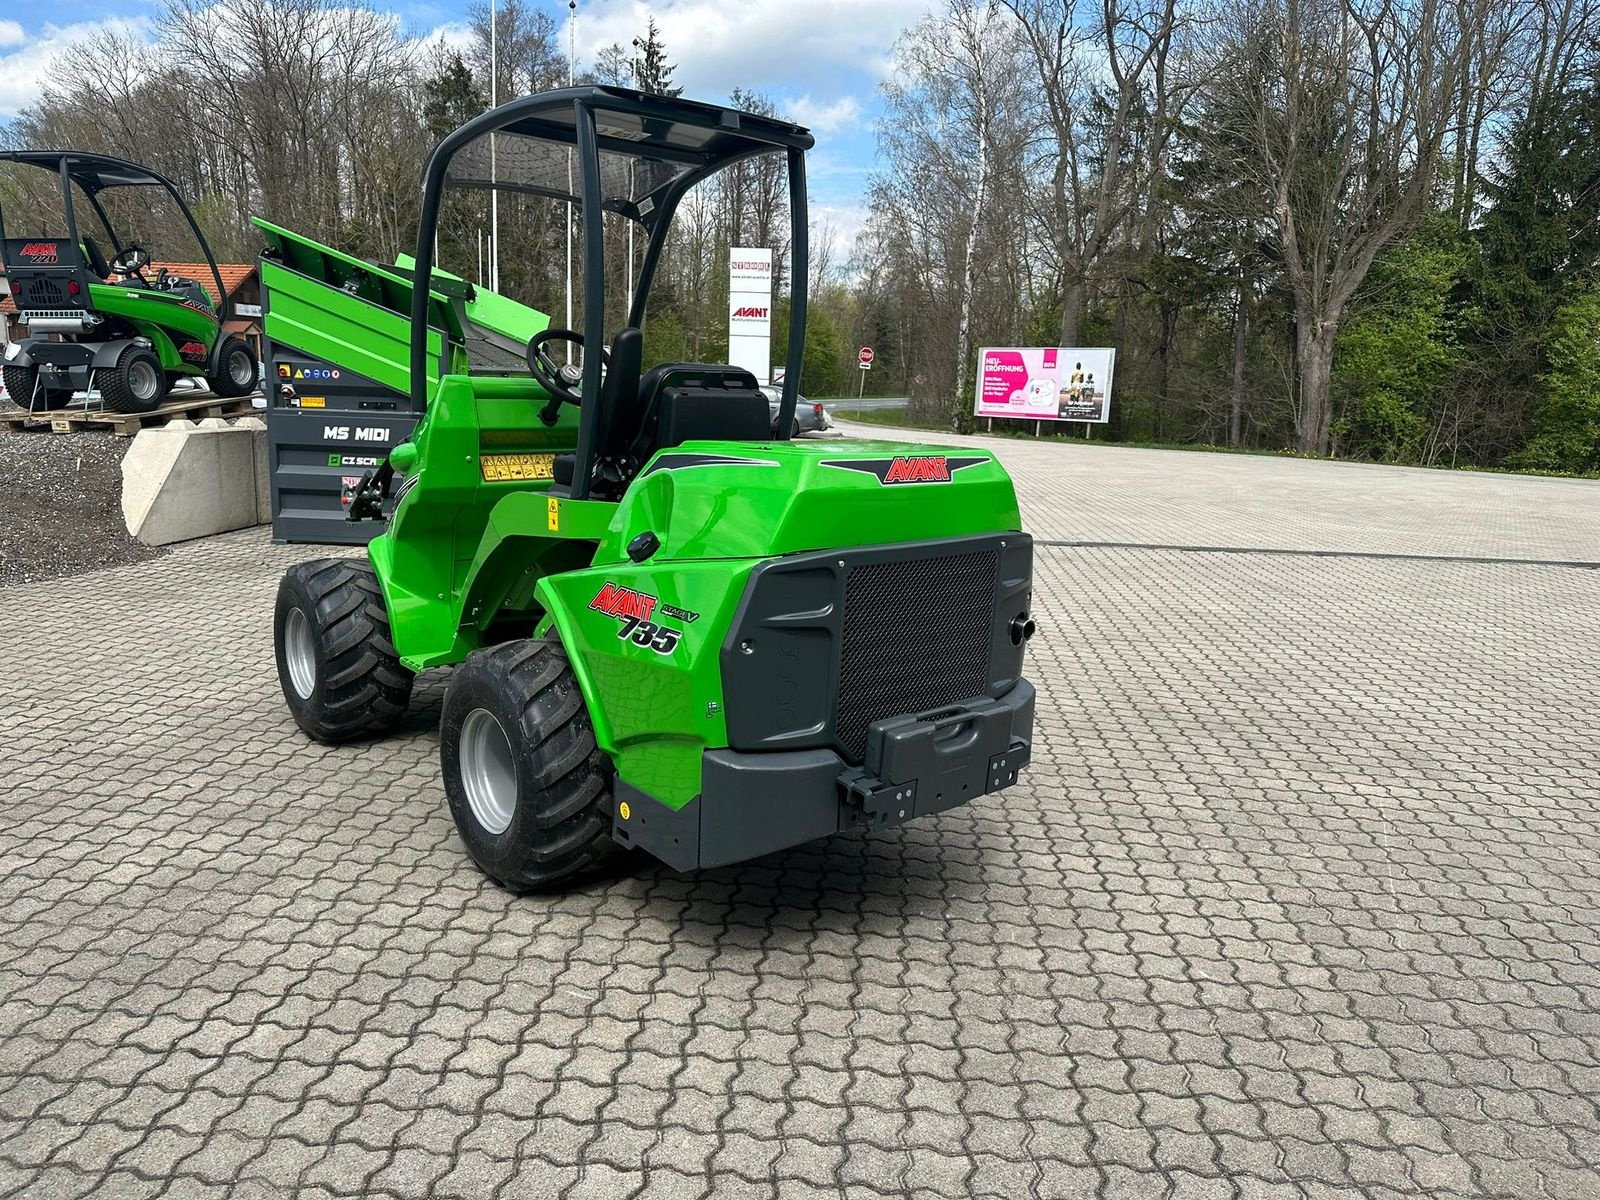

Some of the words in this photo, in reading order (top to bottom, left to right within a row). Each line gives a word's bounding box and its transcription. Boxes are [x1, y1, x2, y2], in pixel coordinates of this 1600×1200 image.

[20, 243, 57, 256] AVANT
[30, 254, 58, 264] 220
[732, 307, 768, 317] AVANT
[323, 426, 350, 440] MS
[355, 427, 390, 442] MIDI
[885, 457, 949, 482] AVANT
[590, 582, 657, 621] AVANT
[662, 605, 687, 617] STAGE
[618, 615, 681, 655] 735
